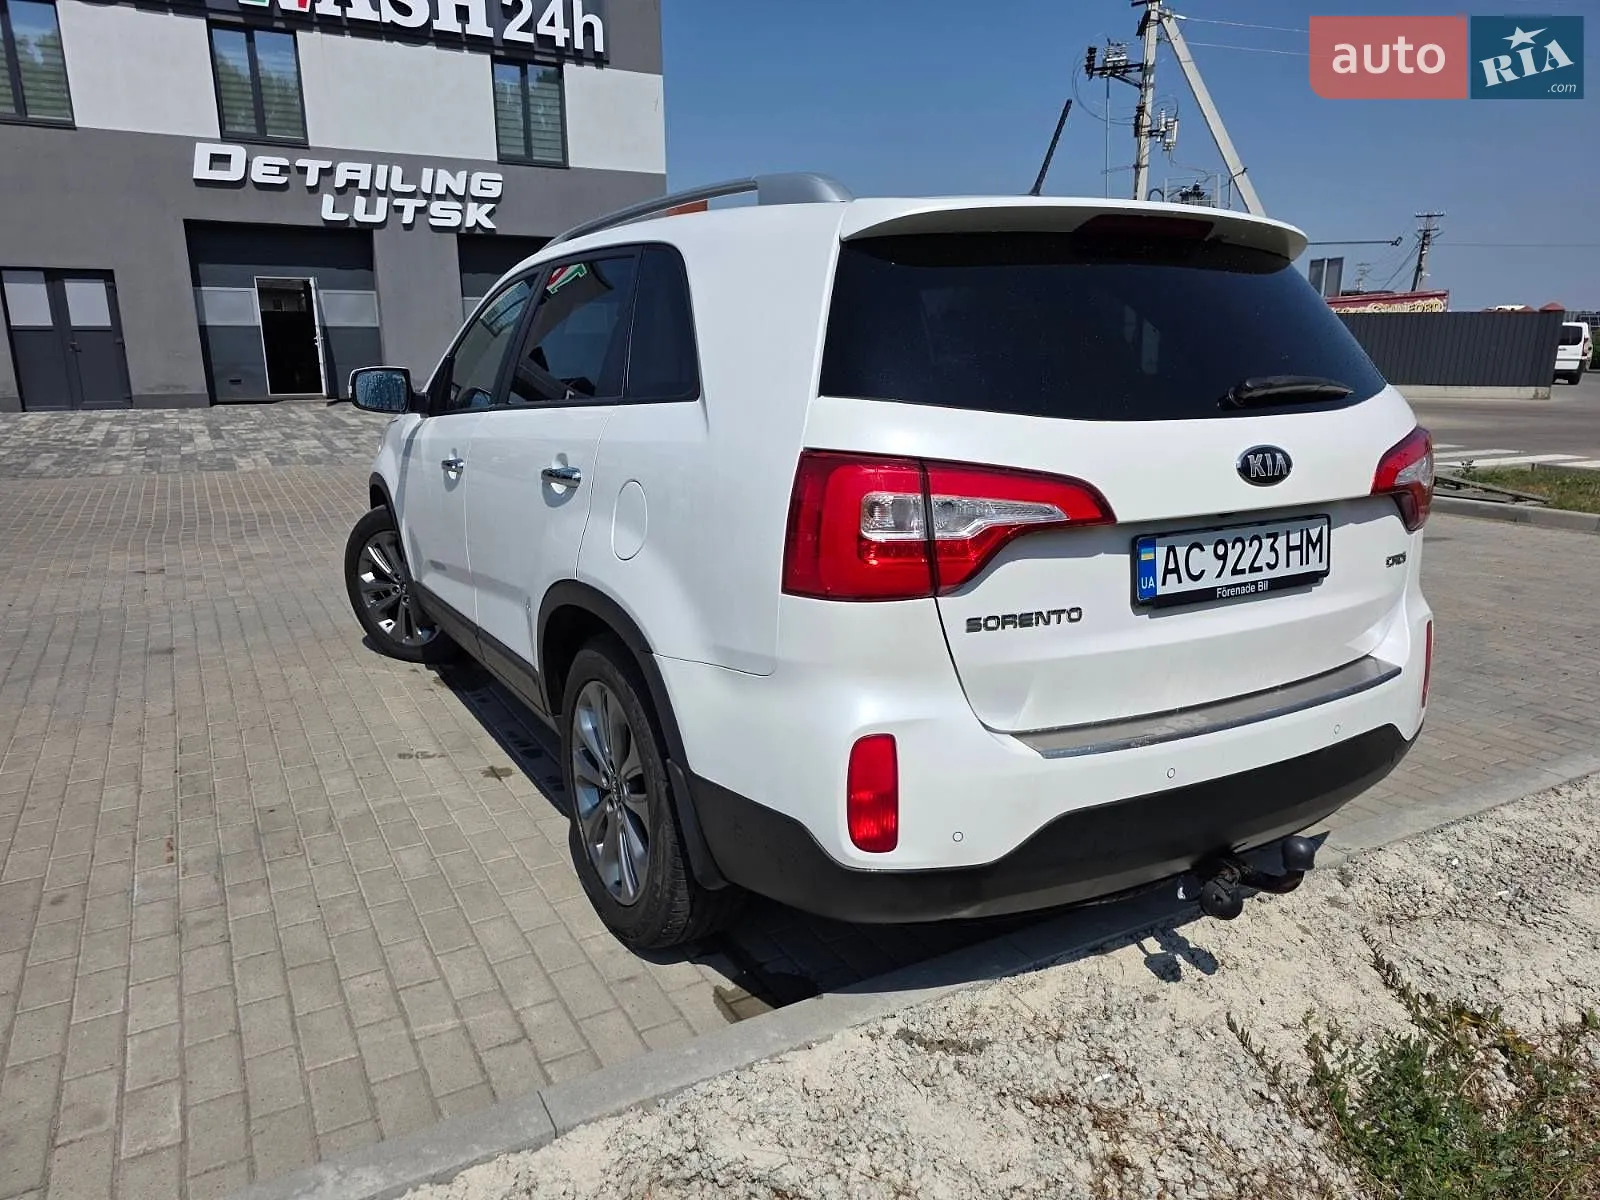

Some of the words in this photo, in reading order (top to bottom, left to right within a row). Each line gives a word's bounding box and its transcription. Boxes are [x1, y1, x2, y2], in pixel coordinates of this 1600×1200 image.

[502, 0, 604, 52] 24h
[193, 142, 503, 197] DETAILING
[320, 193, 497, 229] LUTSK
[1248, 453, 1287, 477] KIA
[1161, 541, 1206, 587] AC
[1213, 532, 1280, 579] 9223
[1286, 526, 1324, 569] HM
[1141, 577, 1155, 590] UA
[1216, 582, 1256, 599] Förenade
[1257, 580, 1269, 592] Bil
[965, 606, 1083, 633] SORENTO
